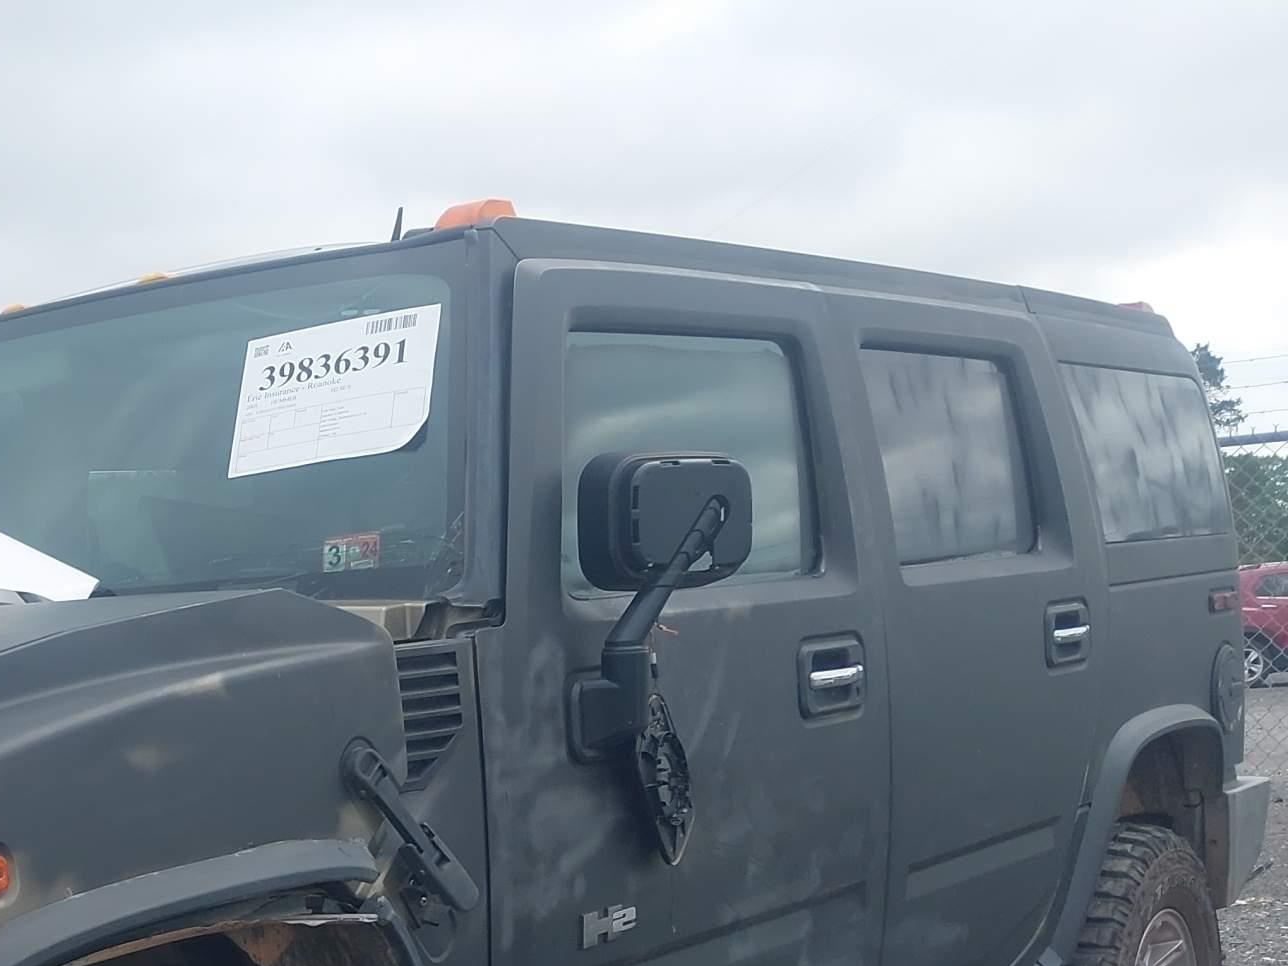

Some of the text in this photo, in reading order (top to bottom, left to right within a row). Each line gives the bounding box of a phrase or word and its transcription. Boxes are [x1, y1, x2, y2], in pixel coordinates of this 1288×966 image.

[259, 338, 409, 392] 39836391
[264, 386, 301, 400] Insurance
[307, 378, 342, 390] Roanoke
[327, 545, 342, 567] 3
[582, 904, 636, 950] H2
